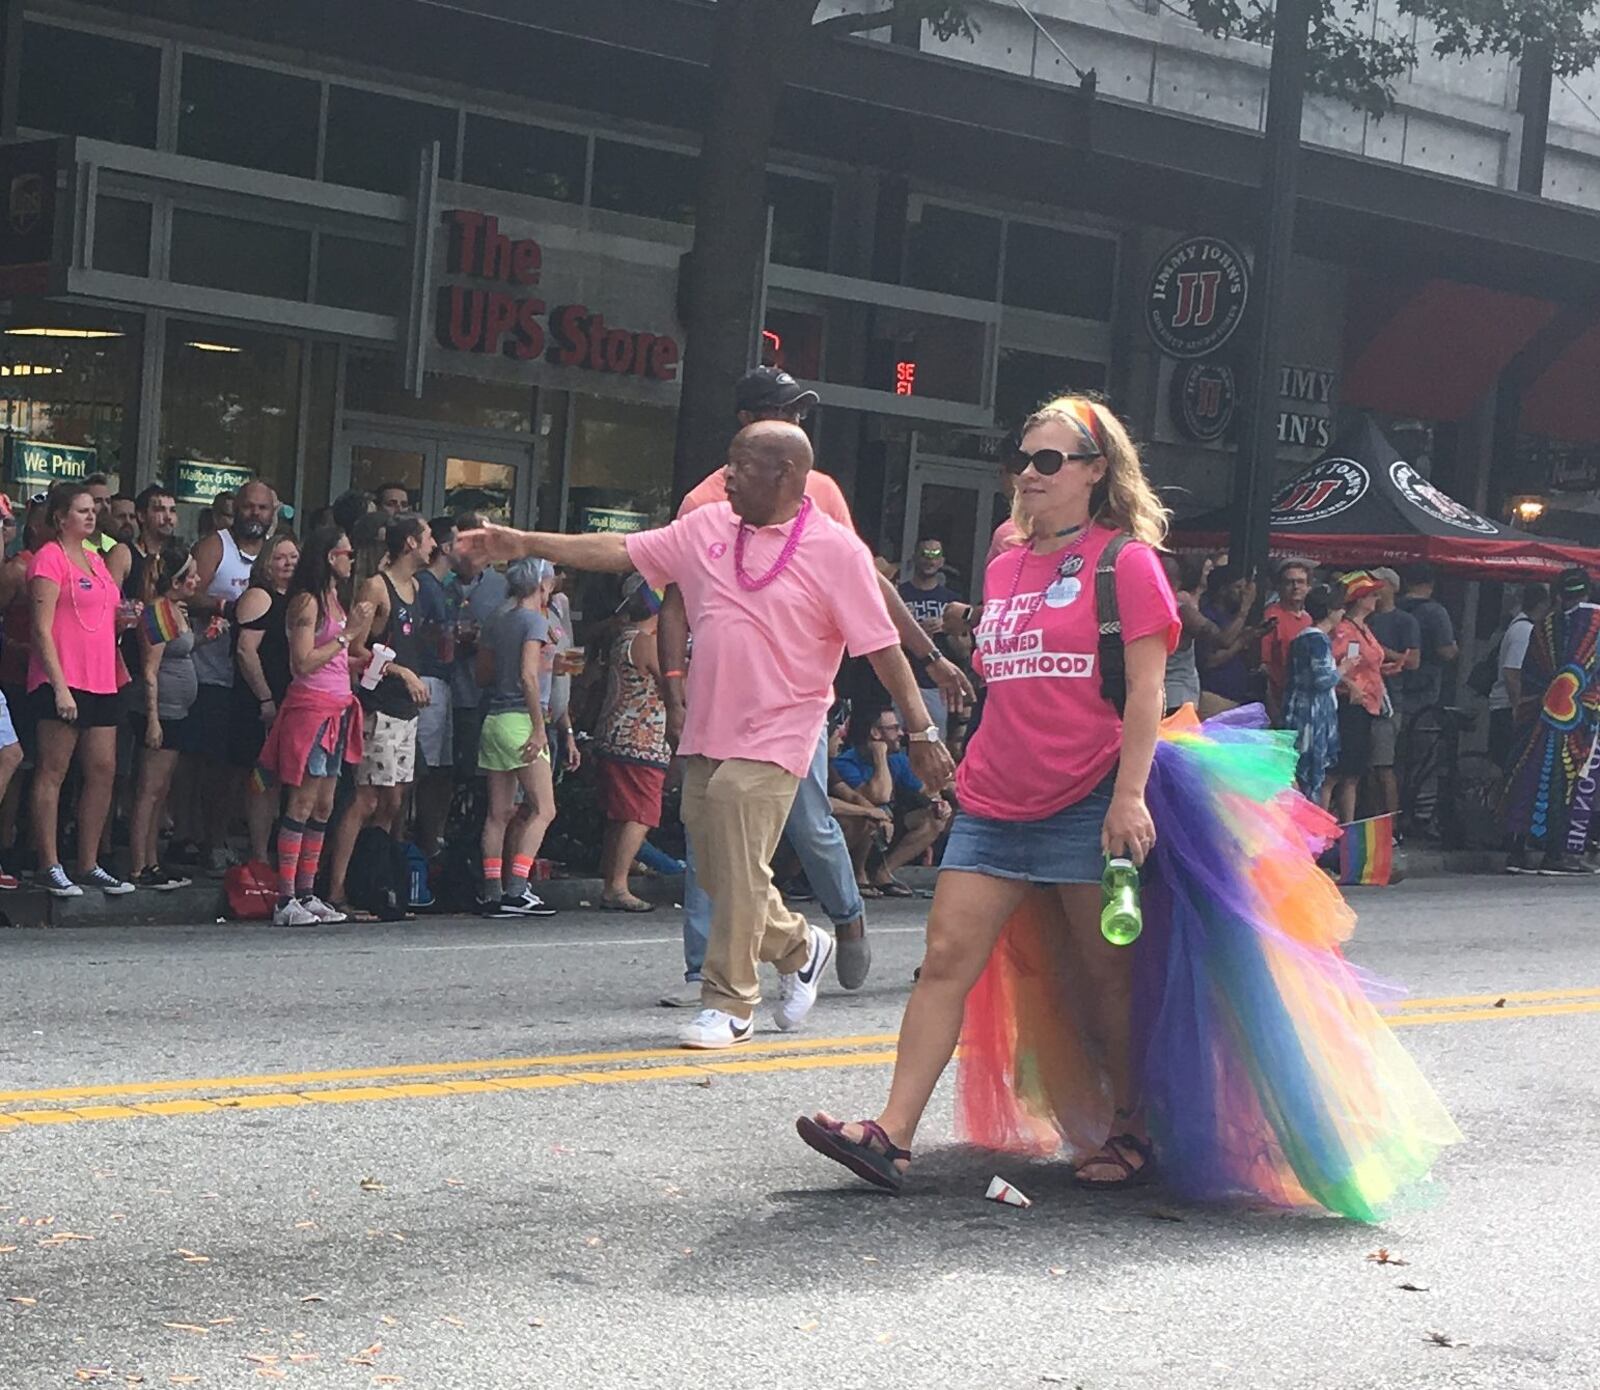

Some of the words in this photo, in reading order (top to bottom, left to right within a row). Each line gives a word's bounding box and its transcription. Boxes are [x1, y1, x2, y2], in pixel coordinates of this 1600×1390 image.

[447, 209, 542, 286] The
[1152, 246, 1197, 300] JIMMY
[1202, 244, 1241, 294] JOHN'S
[1171, 270, 1222, 328] JJ
[441, 285, 546, 361] UPS
[553, 303, 679, 381] Store
[23, 451, 48, 473] We
[52, 454, 86, 478] Print
[179, 468, 213, 483] Mailbox
